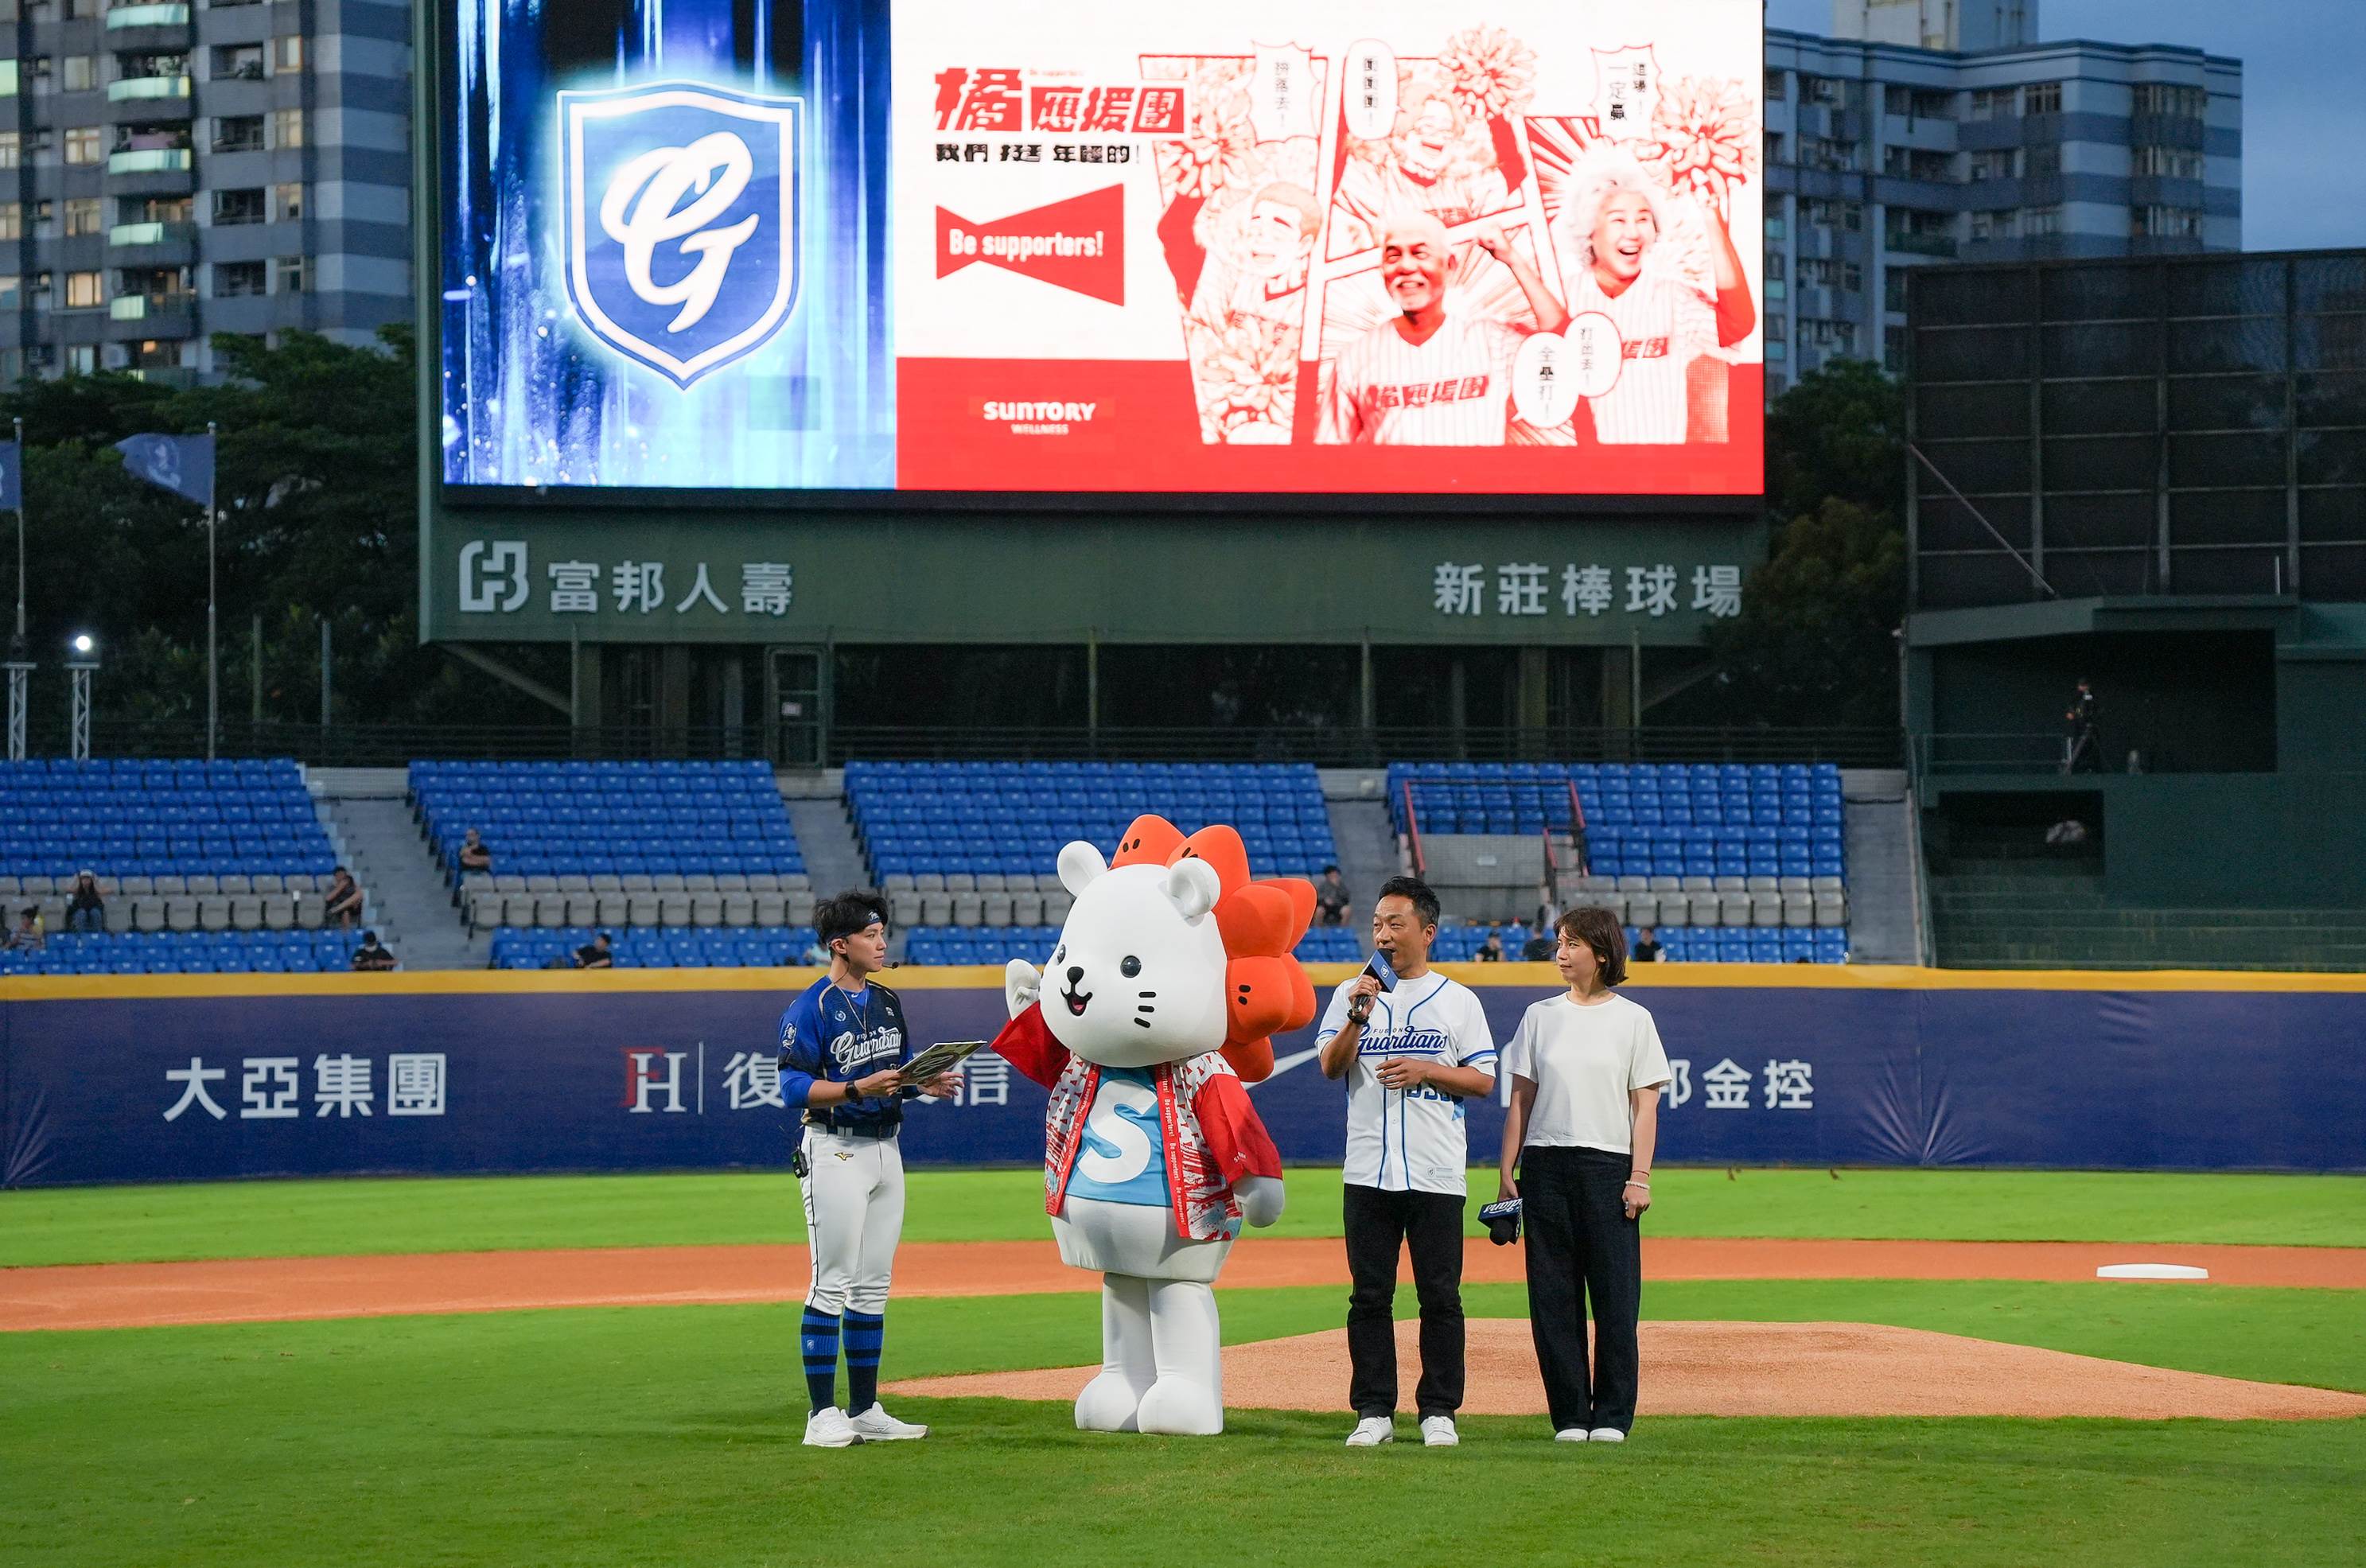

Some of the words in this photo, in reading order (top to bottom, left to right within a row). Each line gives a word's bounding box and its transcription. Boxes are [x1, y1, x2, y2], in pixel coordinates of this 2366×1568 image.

[949, 228, 978, 255] Be
[982, 230, 1104, 263] supporters!
[983, 400, 1096, 422] SUNTORY
[1010, 423, 1069, 435] WELLNESS
[547, 559, 793, 616] 富邦人壽
[1434, 562, 1744, 617] 新莊棒球場
[830, 1025, 902, 1076] Guardian
[162, 1052, 447, 1123] 大亞集團
[1165, 1107, 1175, 1137] supporters!
[1170, 1151, 1181, 1181] supporters!
